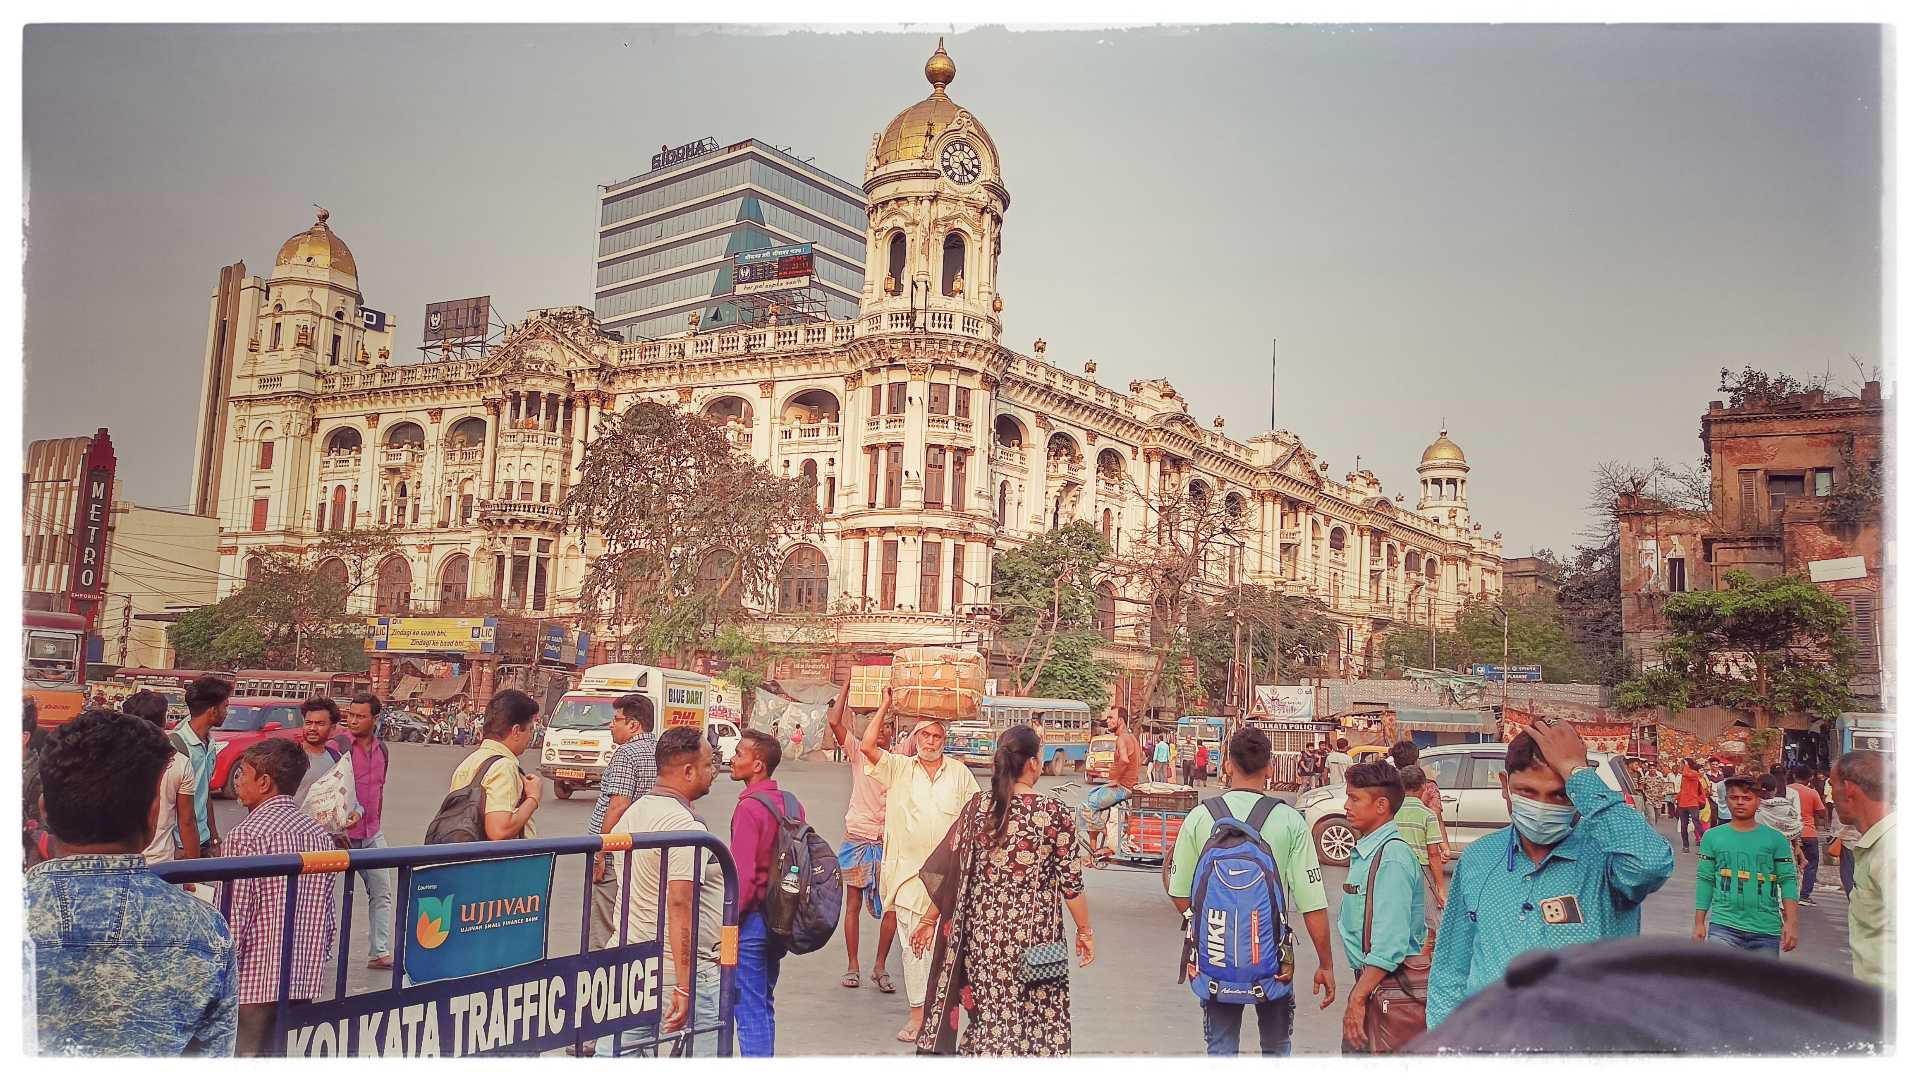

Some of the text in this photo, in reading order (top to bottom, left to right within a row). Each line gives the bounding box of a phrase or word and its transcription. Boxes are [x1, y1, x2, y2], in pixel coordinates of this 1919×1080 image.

[455, 303, 482, 330] LIC
[81, 481, 105, 586] METRO
[480, 628, 493, 639] LIC
[668, 687, 685, 704] BLUE
[686, 689, 704, 705] DART
[672, 710, 697, 725] DHL
[1253, 722, 1317, 731] KOLKATA POLICE
[484, 921, 501, 930] SMALL
[502, 918, 524, 927] FINANCE
[1207, 908, 1228, 968] NIKE
[450, 975, 567, 1058] TRAFFIC
[574, 956, 660, 1030] POLICE
